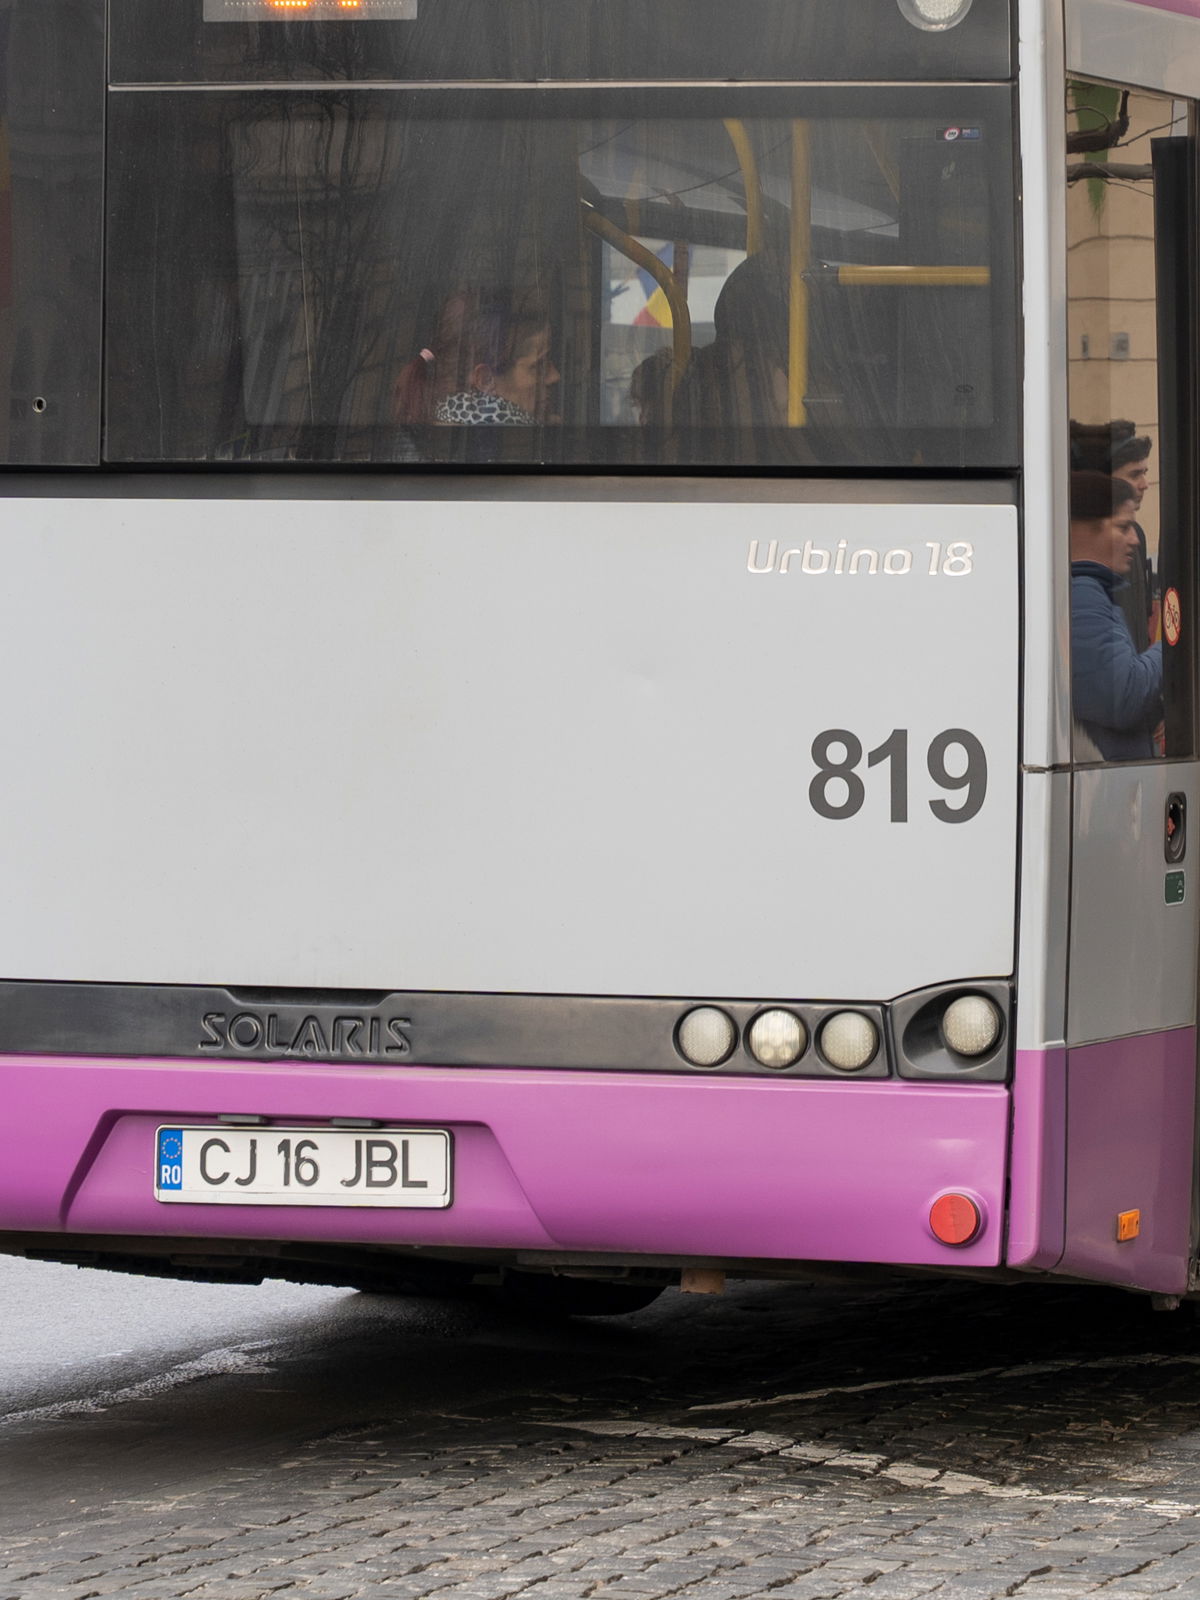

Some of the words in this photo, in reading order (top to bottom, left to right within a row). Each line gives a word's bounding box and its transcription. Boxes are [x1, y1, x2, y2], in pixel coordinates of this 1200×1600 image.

[747, 539, 913, 575] Urbino
[925, 541, 974, 576] 18
[808, 728, 988, 824] 819
[198, 1011, 412, 1057] SOLARIS
[161, 1164, 182, 1185] RO
[200, 1138, 257, 1186] CJ
[277, 1138, 320, 1187] 16
[340, 1139, 428, 1188] JBL
